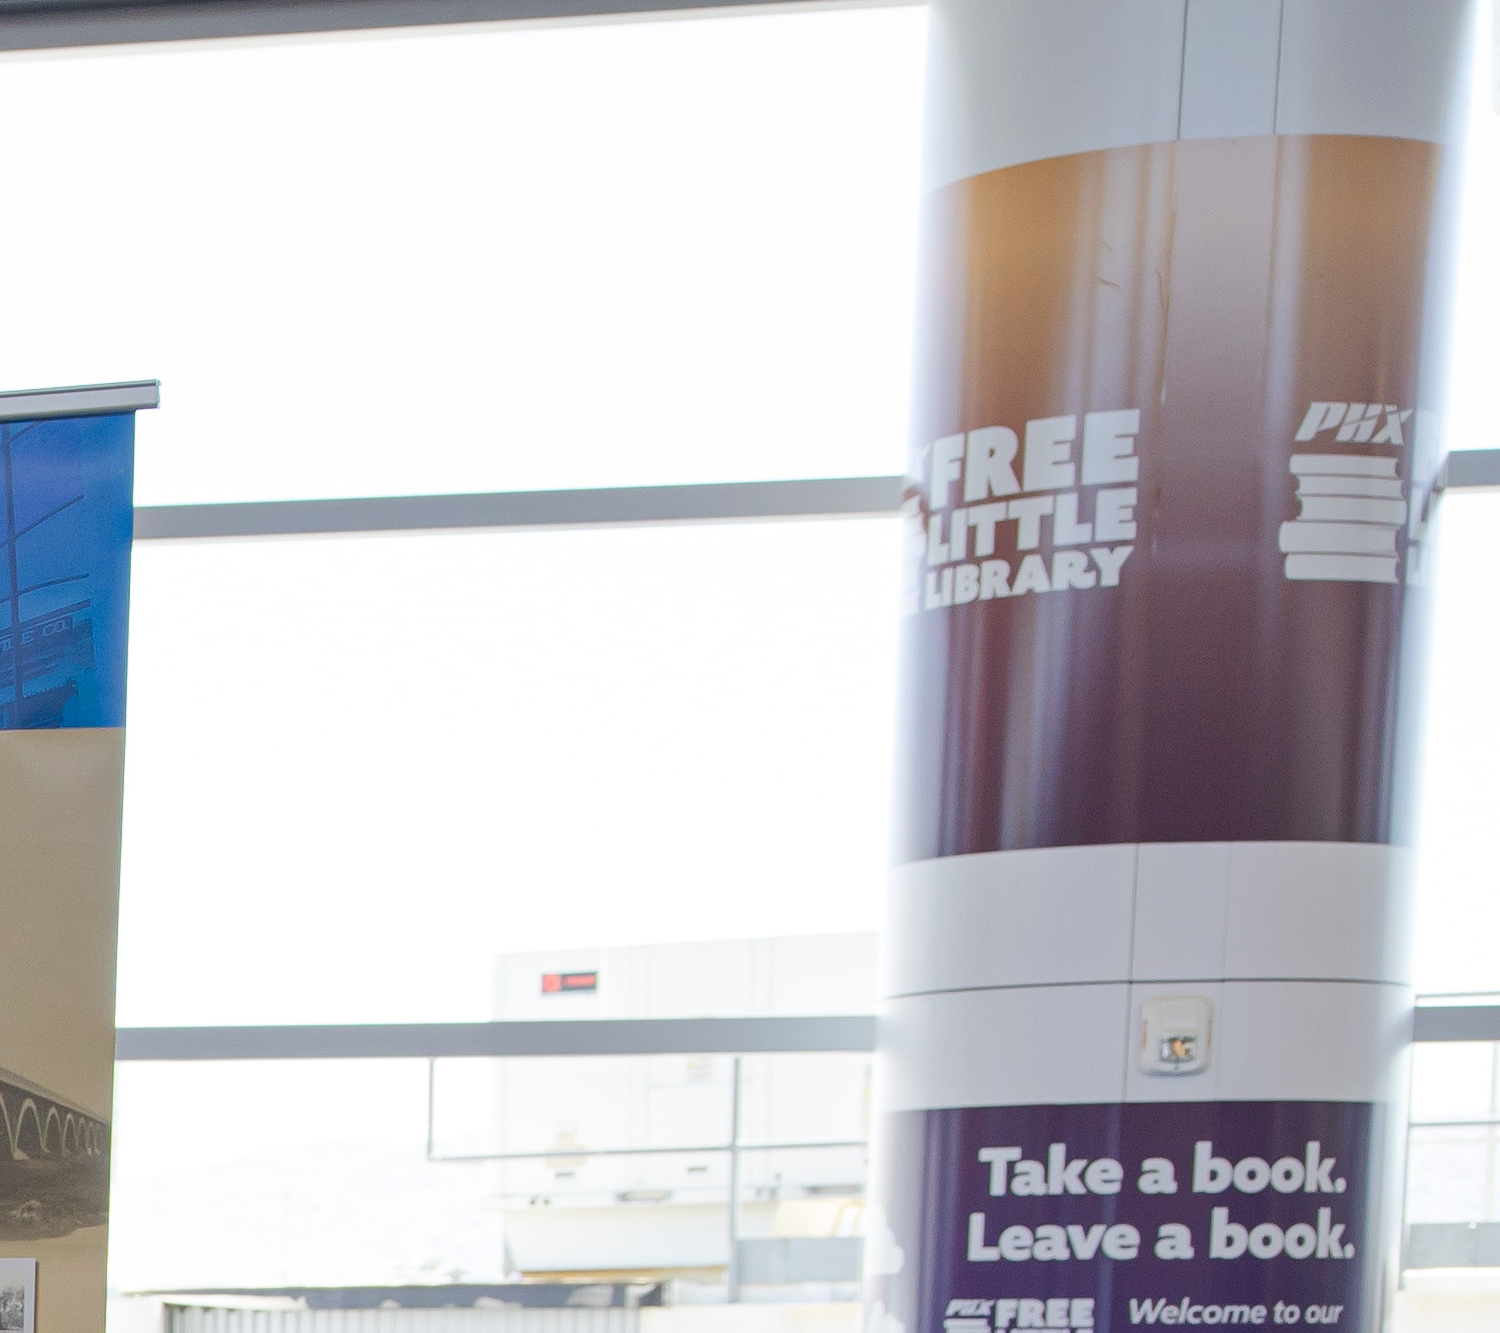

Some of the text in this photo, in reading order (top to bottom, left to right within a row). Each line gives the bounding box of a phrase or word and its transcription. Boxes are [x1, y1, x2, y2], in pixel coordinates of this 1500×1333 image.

[1296, 402, 1413, 445] PHX
[930, 409, 1139, 510] FREE
[927, 487, 1137, 568] LITTLE
[924, 545, 1134, 611] LIBRARY
[978, 1142, 1347, 1197] Take a book.
[967, 1208, 1355, 1262] Leave a book.
[995, 1298, 1094, 1327] FREE
[1128, 1297, 1344, 1325] Welcome to our
